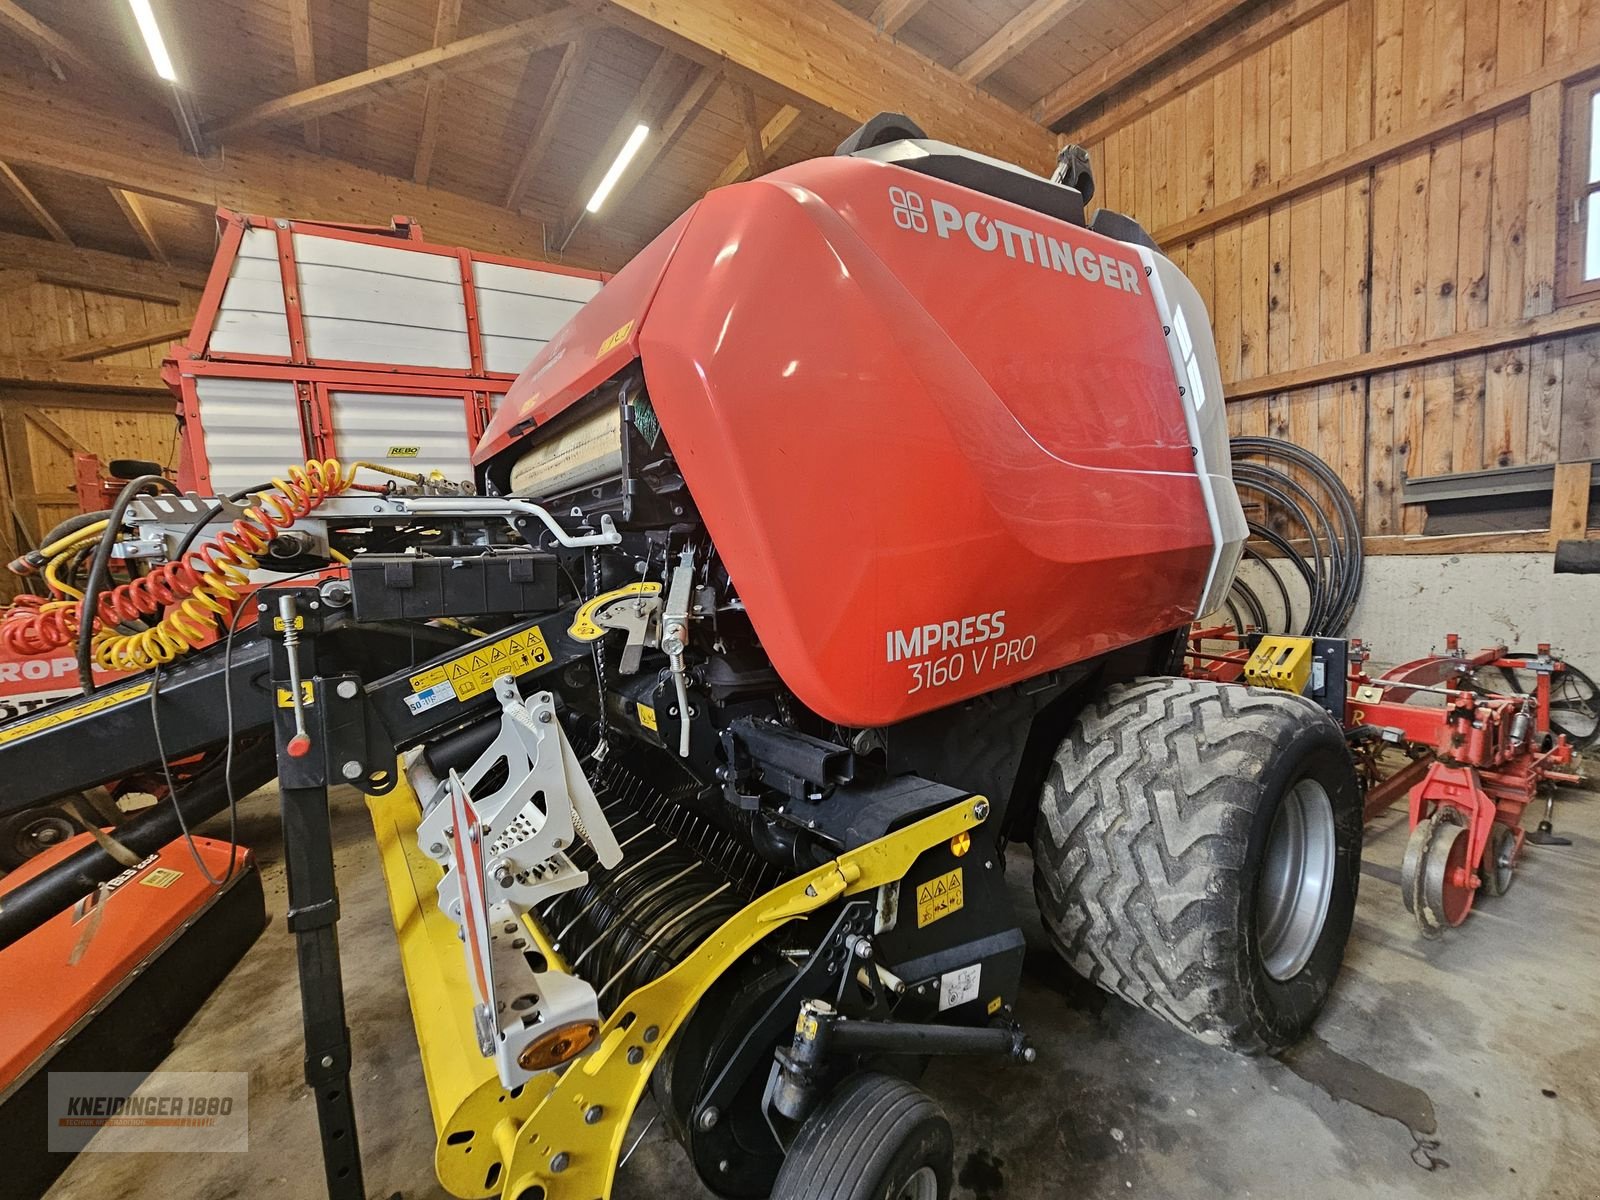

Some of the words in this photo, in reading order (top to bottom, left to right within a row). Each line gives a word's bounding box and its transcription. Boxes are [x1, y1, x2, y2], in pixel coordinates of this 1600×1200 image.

[931, 199, 1142, 295] PÖTTINGER
[886, 610, 1006, 662] IMPRESS
[908, 653, 965, 694] 3160
[972, 646, 988, 675] V
[992, 635, 1036, 670] PRO
